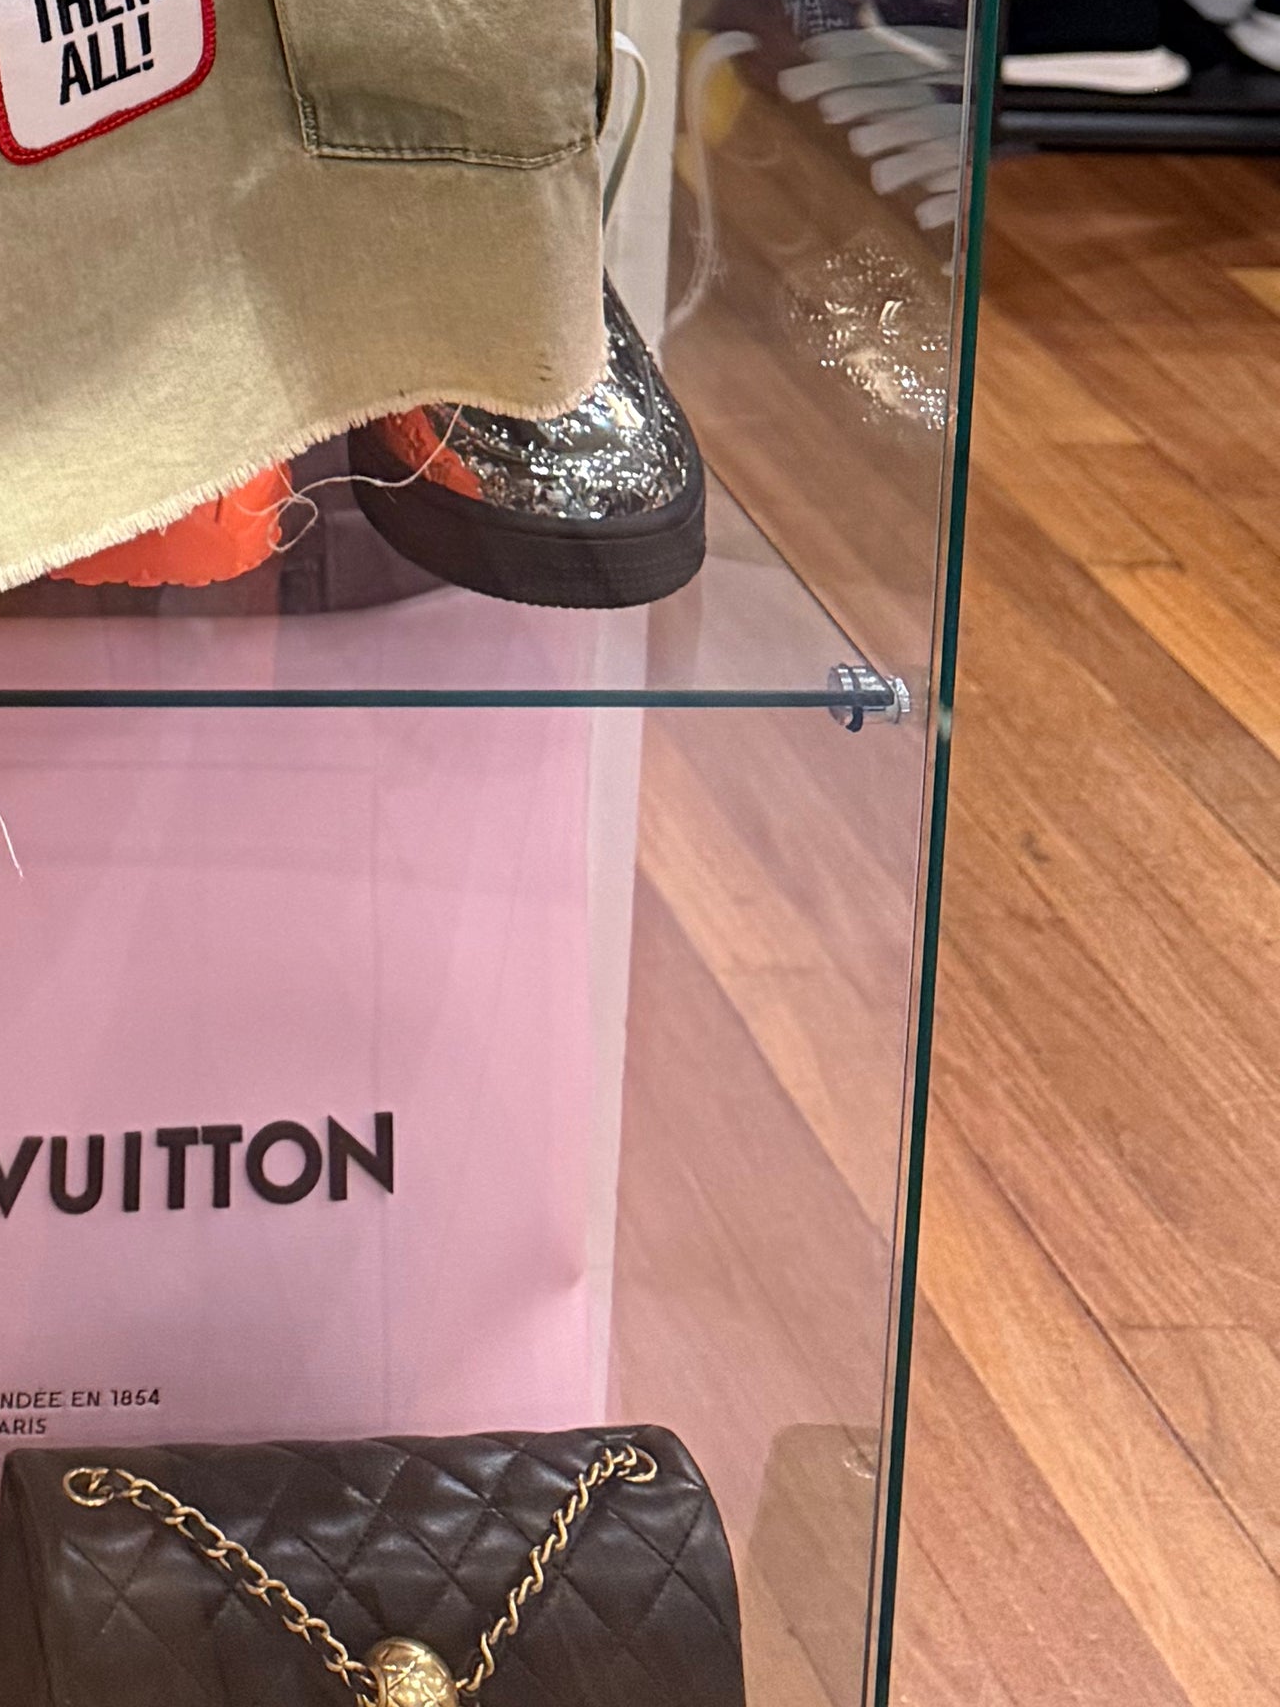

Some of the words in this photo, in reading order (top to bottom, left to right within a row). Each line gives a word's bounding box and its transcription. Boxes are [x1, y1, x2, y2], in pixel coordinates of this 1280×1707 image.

[59, 11, 155, 106] ALL!
[71, 1390, 101, 1408] EN
[111, 1388, 161, 1407] 1854
